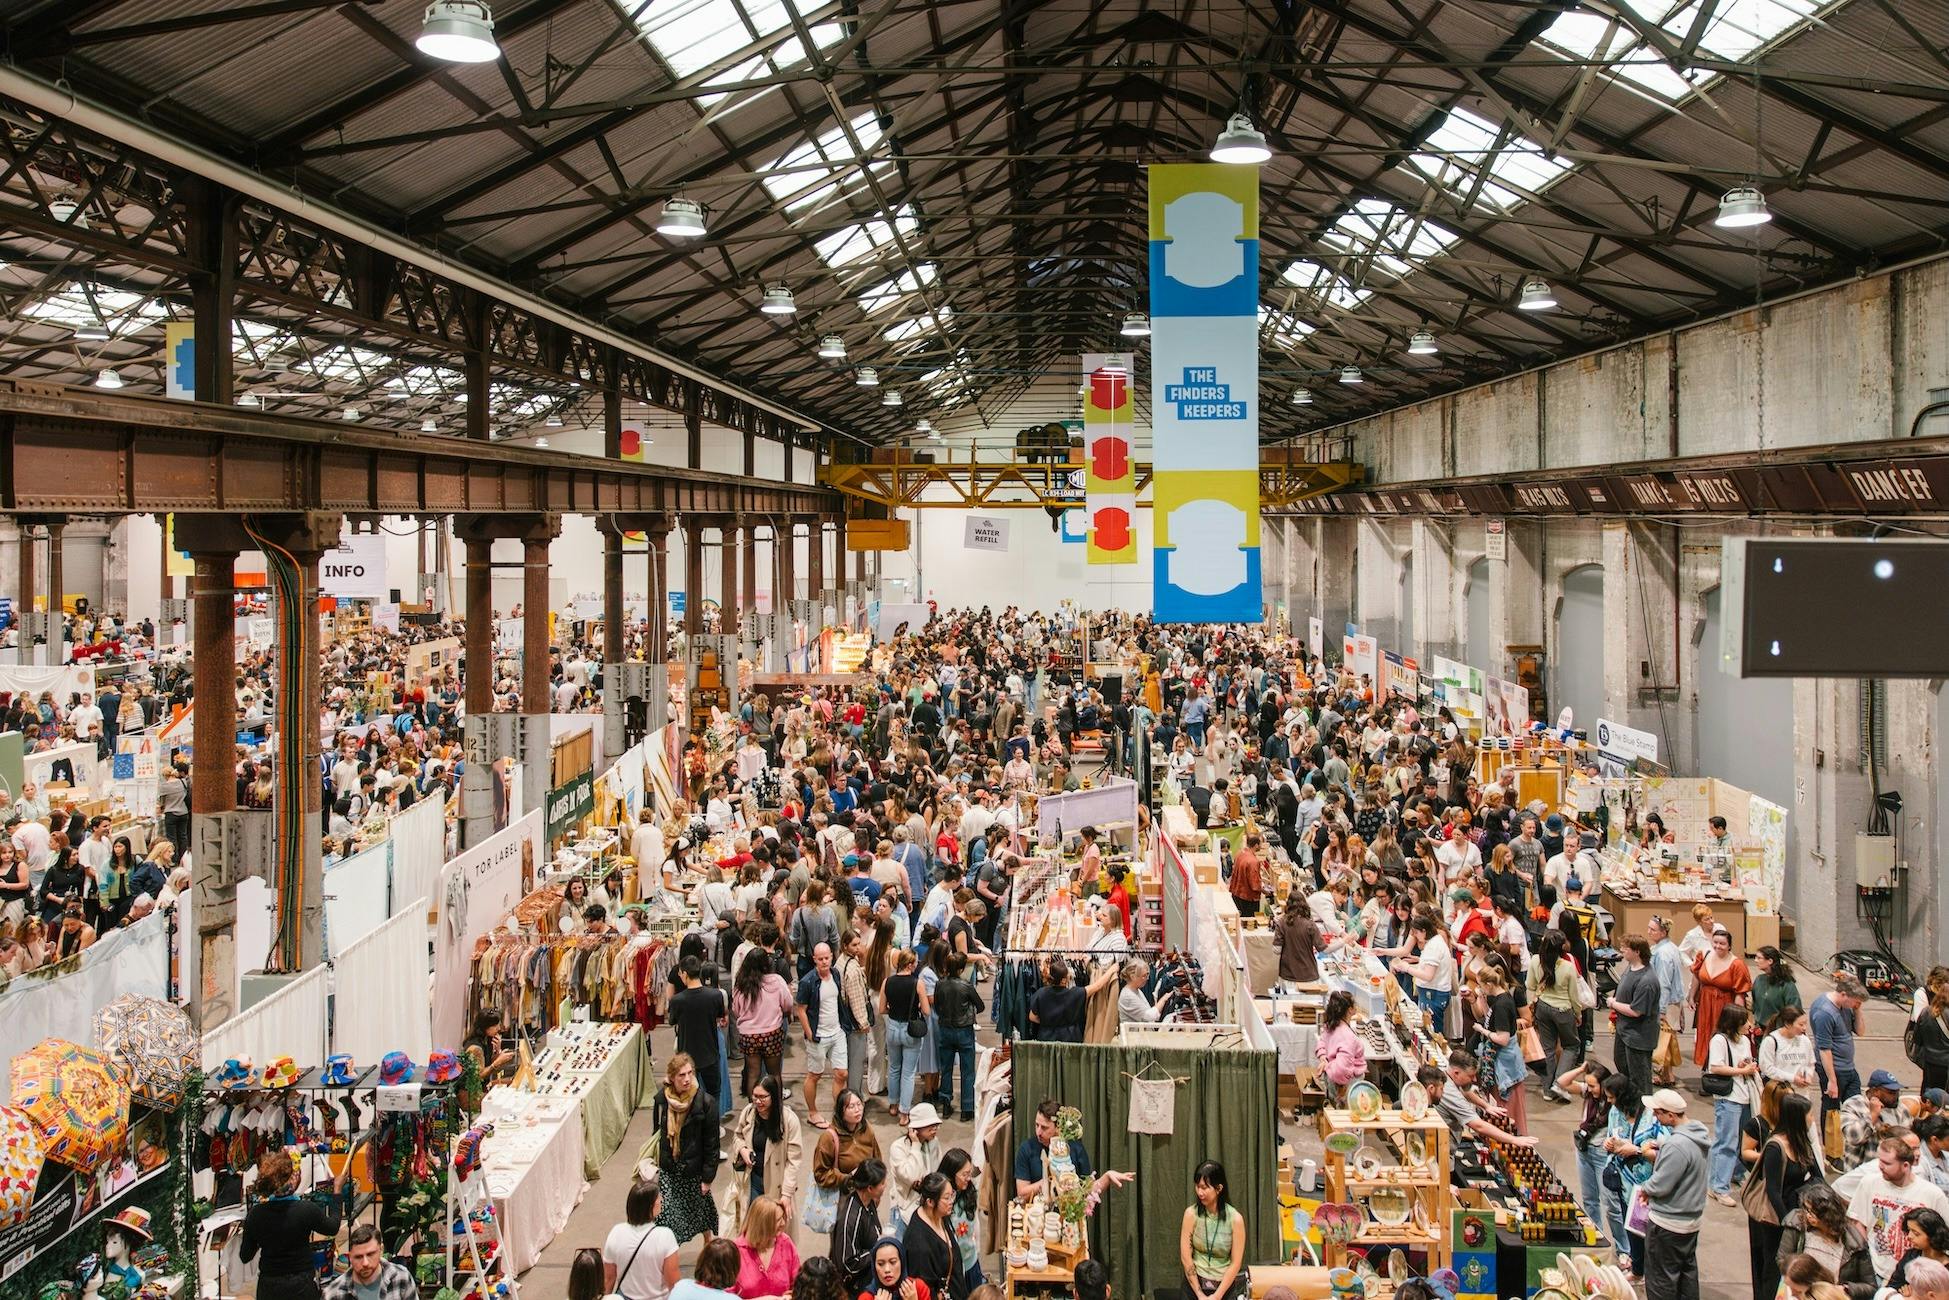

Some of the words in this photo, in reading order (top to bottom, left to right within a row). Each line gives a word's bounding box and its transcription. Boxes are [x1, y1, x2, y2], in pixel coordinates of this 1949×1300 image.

[1189, 369, 1214, 383] THE
[1170, 386, 1226, 400] FINDERS
[1183, 404, 1241, 418] KEEPERS
[1694, 479, 1740, 503] VOLTS
[974, 528, 1000, 537] WATER
[974, 535, 999, 543] REFILL
[325, 565, 365, 577] INFO
[1635, 738, 1656, 753] Stamp
[475, 857, 491, 877] TOR
[495, 841, 517, 864] LABEL
[1872, 1198, 1900, 1211] Rolling
